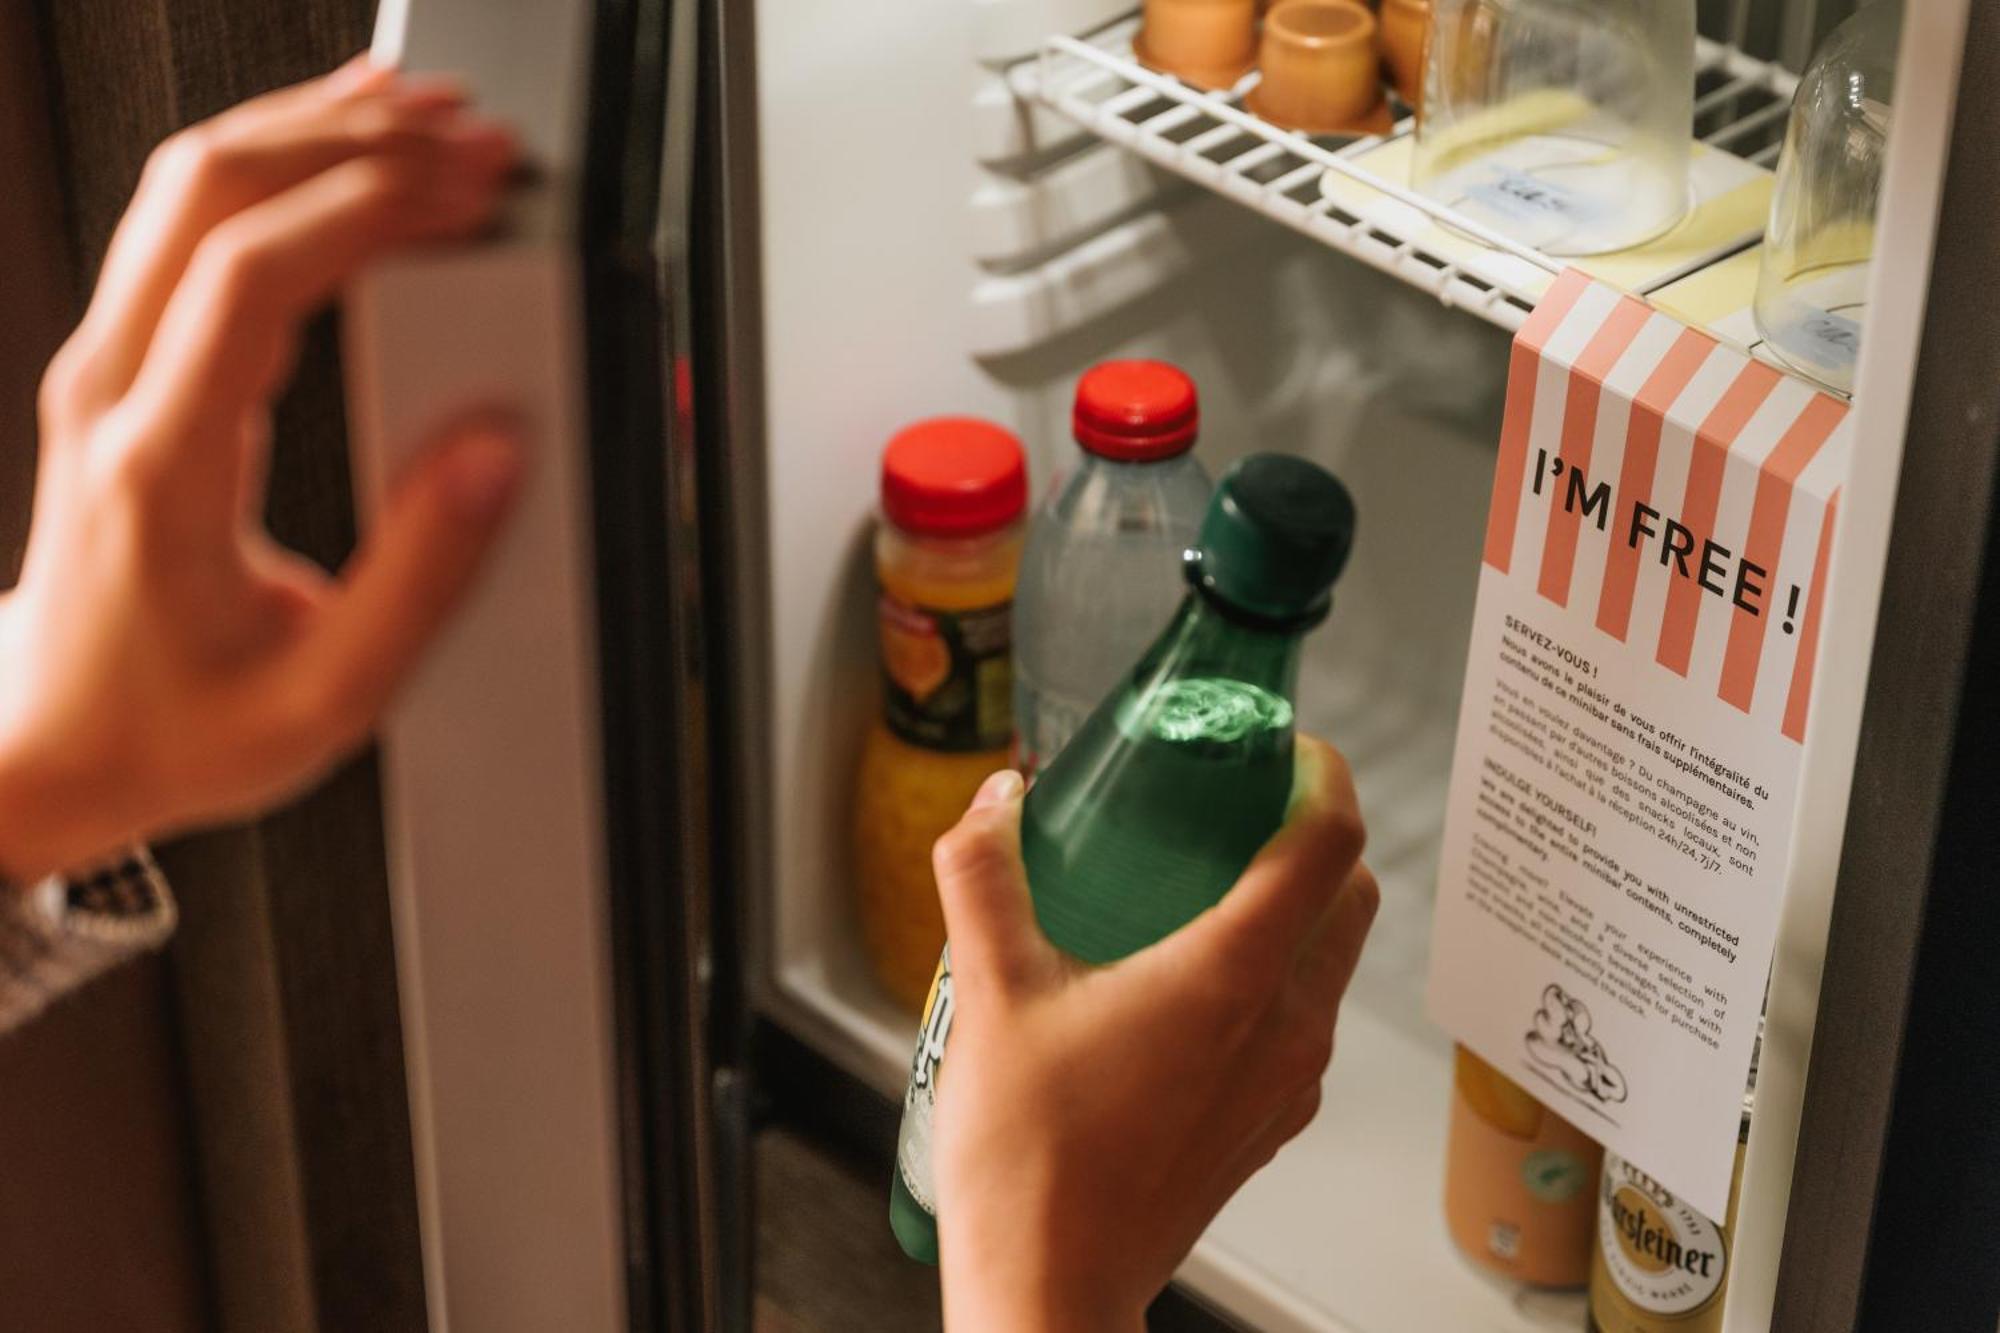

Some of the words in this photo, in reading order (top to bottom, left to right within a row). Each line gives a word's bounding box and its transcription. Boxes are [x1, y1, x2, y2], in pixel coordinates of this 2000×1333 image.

[1533, 448, 1611, 532] I'M
[1628, 501, 1767, 617] FREE
[1782, 584, 1801, 635] !
[1505, 614, 1590, 674] SERVEZ-VOUS
[1592, 665, 1598, 678] !
[1530, 654, 1560, 677] avons
[1563, 671, 1573, 685] le
[1576, 681, 1609, 706] plaisir
[1613, 703, 1626, 717] de
[1630, 713, 1655, 734] vous
[1658, 730, 1685, 751] offrir
[1689, 745, 1750, 789] l'intégralité
[1753, 785, 1768, 800] du
[1540, 676, 1554, 690] de
[1554, 685, 1567, 698] ce
[1568, 693, 1608, 723] minibar
[1610, 718, 1635, 739] sans
[1637, 732, 1661, 755] frais
[1662, 749, 1754, 810] supplémentaires.
[1535, 788, 1596, 837] YOURSELF!
[1572, 726, 1625, 765] davantage
[1629, 758, 1635, 769] ?
[1637, 764, 1653, 782] Du
[1656, 778, 1719, 820] champagne
[1721, 817, 1736, 831] au
[1740, 826, 1759, 846] vin,
[1596, 790, 1606, 804] la
[1607, 798, 1656, 835] réception
[1657, 828, 1697, 861] 24h/24,
[1610, 765, 1657, 802] boissons
[1659, 797, 1718, 838] alcoolisées
[1721, 834, 1732, 847] et
[1735, 842, 1756, 860] non
[1611, 784, 1630, 802] des
[1638, 801, 1675, 829] snacks
[1683, 825, 1720, 858] locaux,
[1728, 855, 1753, 876] sont
[1581, 843, 1620, 873] provide
[1622, 869, 1642, 887] you
[1646, 884, 1669, 904] with
[1673, 901, 1739, 946] unrestricted
[1581, 859, 1622, 890] minibar
[1625, 888, 1673, 925] contents,
[1677, 920, 1736, 964] completely
[1612, 942, 1649, 972] diverse
[1657, 972, 1704, 1008] selection
[1713, 1008, 1725, 1019] of
[1636, 943, 1692, 984] experience
[1704, 985, 1727, 1005] with
[1664, 993, 1694, 1020] along
[1698, 1015, 1721, 1034] with
[1654, 1000, 1669, 1016] for
[1670, 1013, 1719, 1049] purchase
